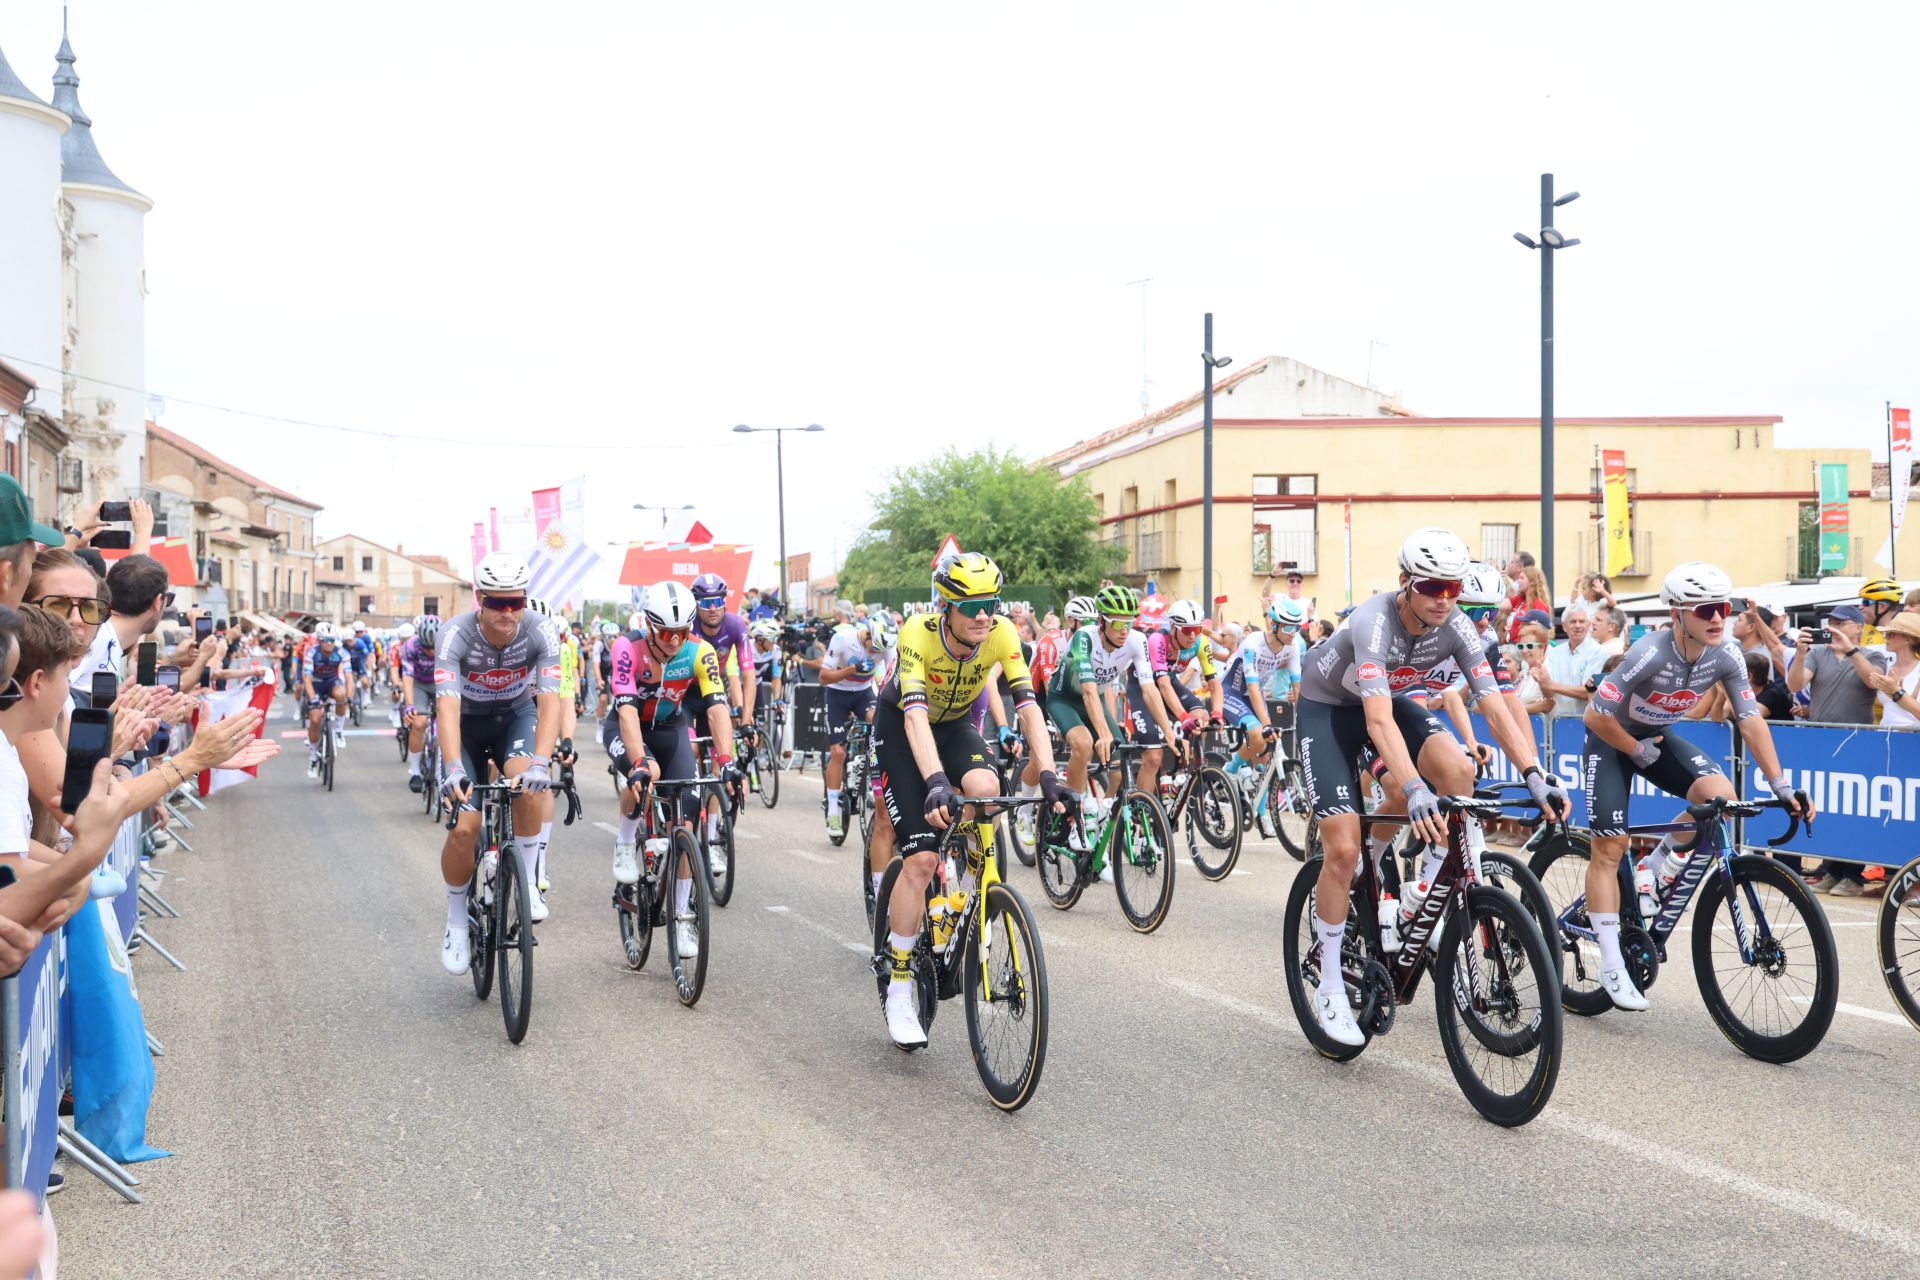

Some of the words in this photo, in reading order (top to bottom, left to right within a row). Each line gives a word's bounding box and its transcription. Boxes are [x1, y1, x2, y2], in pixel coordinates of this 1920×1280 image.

[672, 563, 699, 575] RUEDA
[1454, 613, 1482, 653] Alpecin
[473, 672, 521, 683] Alpecin
[666, 667, 690, 678] caps
[1317, 648, 1340, 675] Alpecin
[1621, 645, 1659, 683] deceuninck
[463, 683, 523, 695] deceuninck
[947, 675, 983, 686] VISMA
[1656, 695, 1699, 707] Alpeci
[1300, 736, 1321, 805] deceuninck
[1585, 754, 1602, 823] deceuninck
[884, 788, 902, 825] VISMA
[1655, 853, 1713, 931] CANYON
[1398, 884, 1452, 966] CANYON
[20, 948, 55, 1187] SHIMAN
